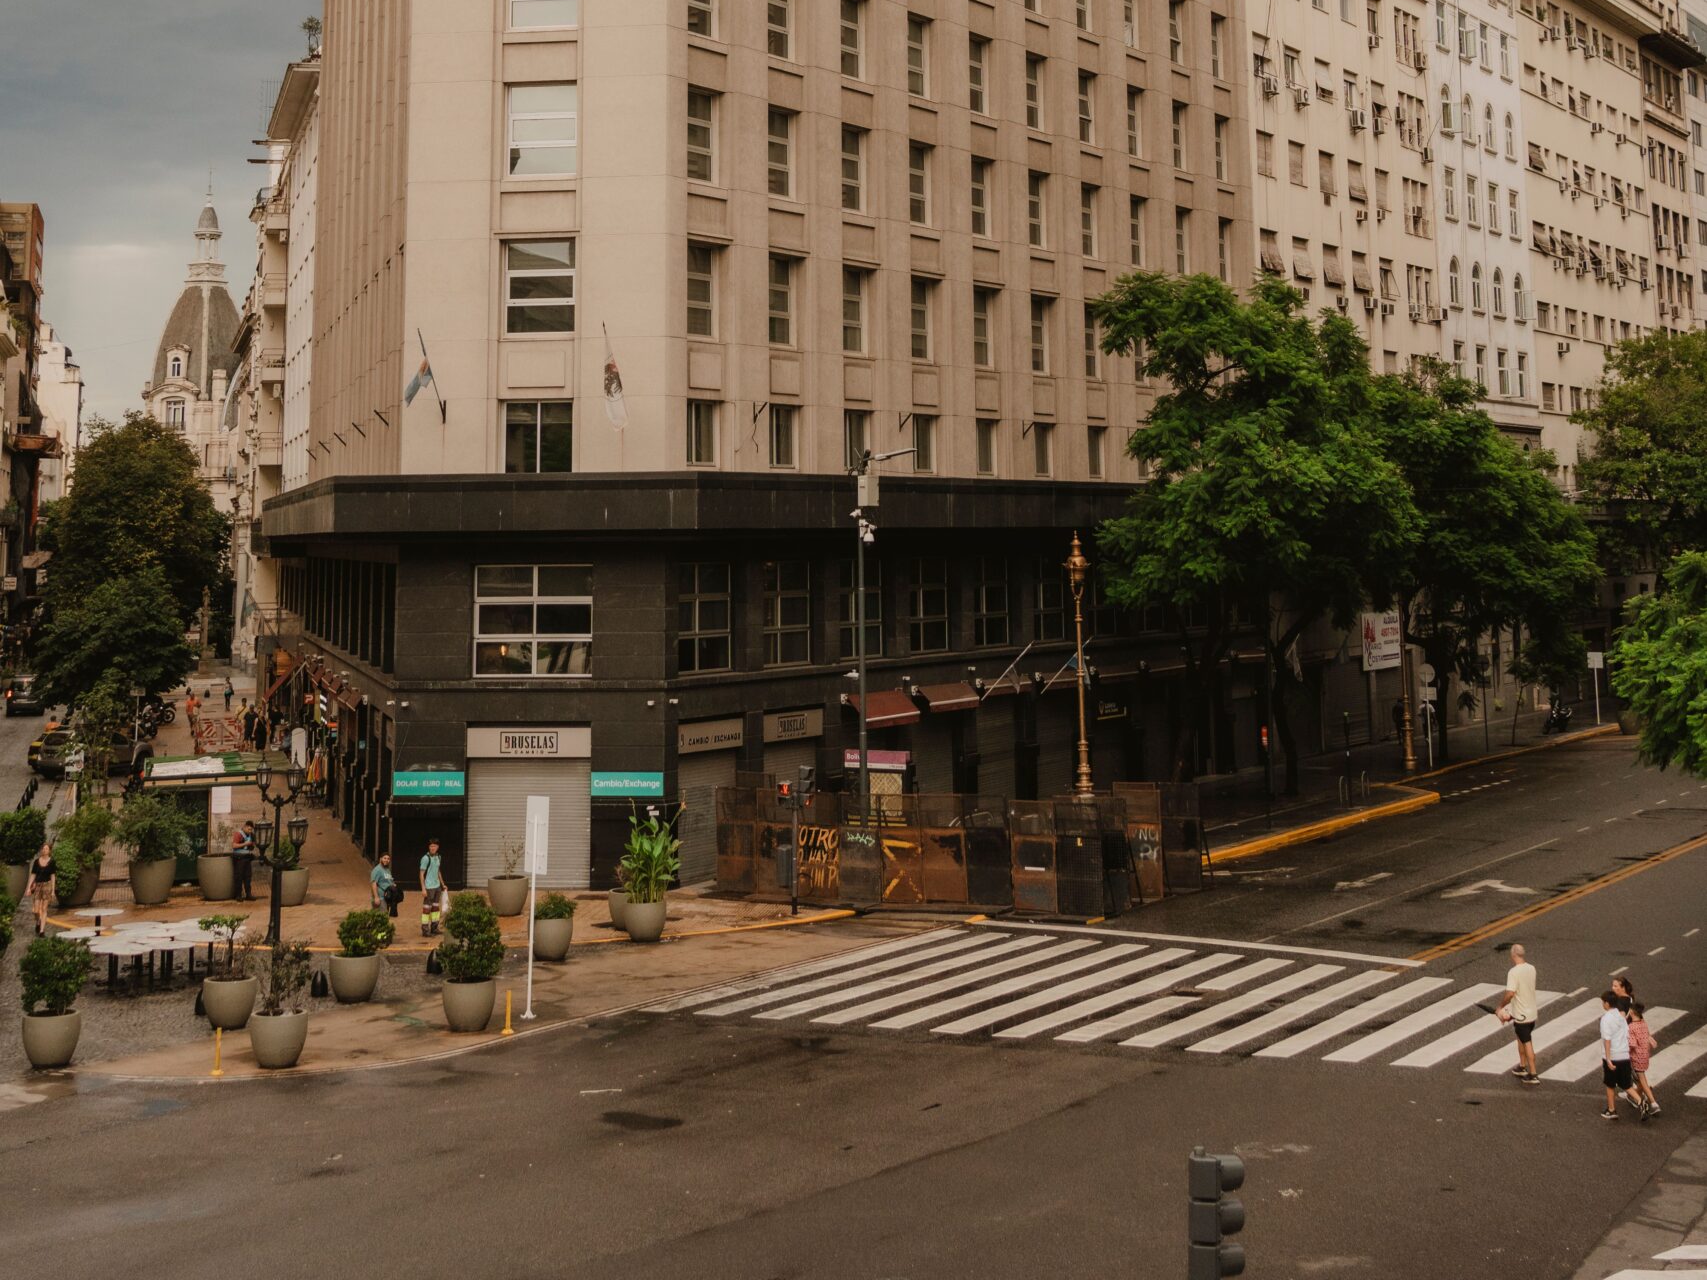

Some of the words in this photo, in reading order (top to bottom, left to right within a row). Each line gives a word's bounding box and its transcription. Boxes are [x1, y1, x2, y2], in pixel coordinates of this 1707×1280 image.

[504, 735, 554, 749] BRUSELAS
[688, 735, 710, 746] CAMBIO
[714, 731, 741, 744] EXCHANGE
[396, 780, 418, 788] DOLAR
[422, 780, 440, 788] EURO
[445, 780, 462, 788] REAL
[594, 779, 660, 790] Cambio/Exchange
